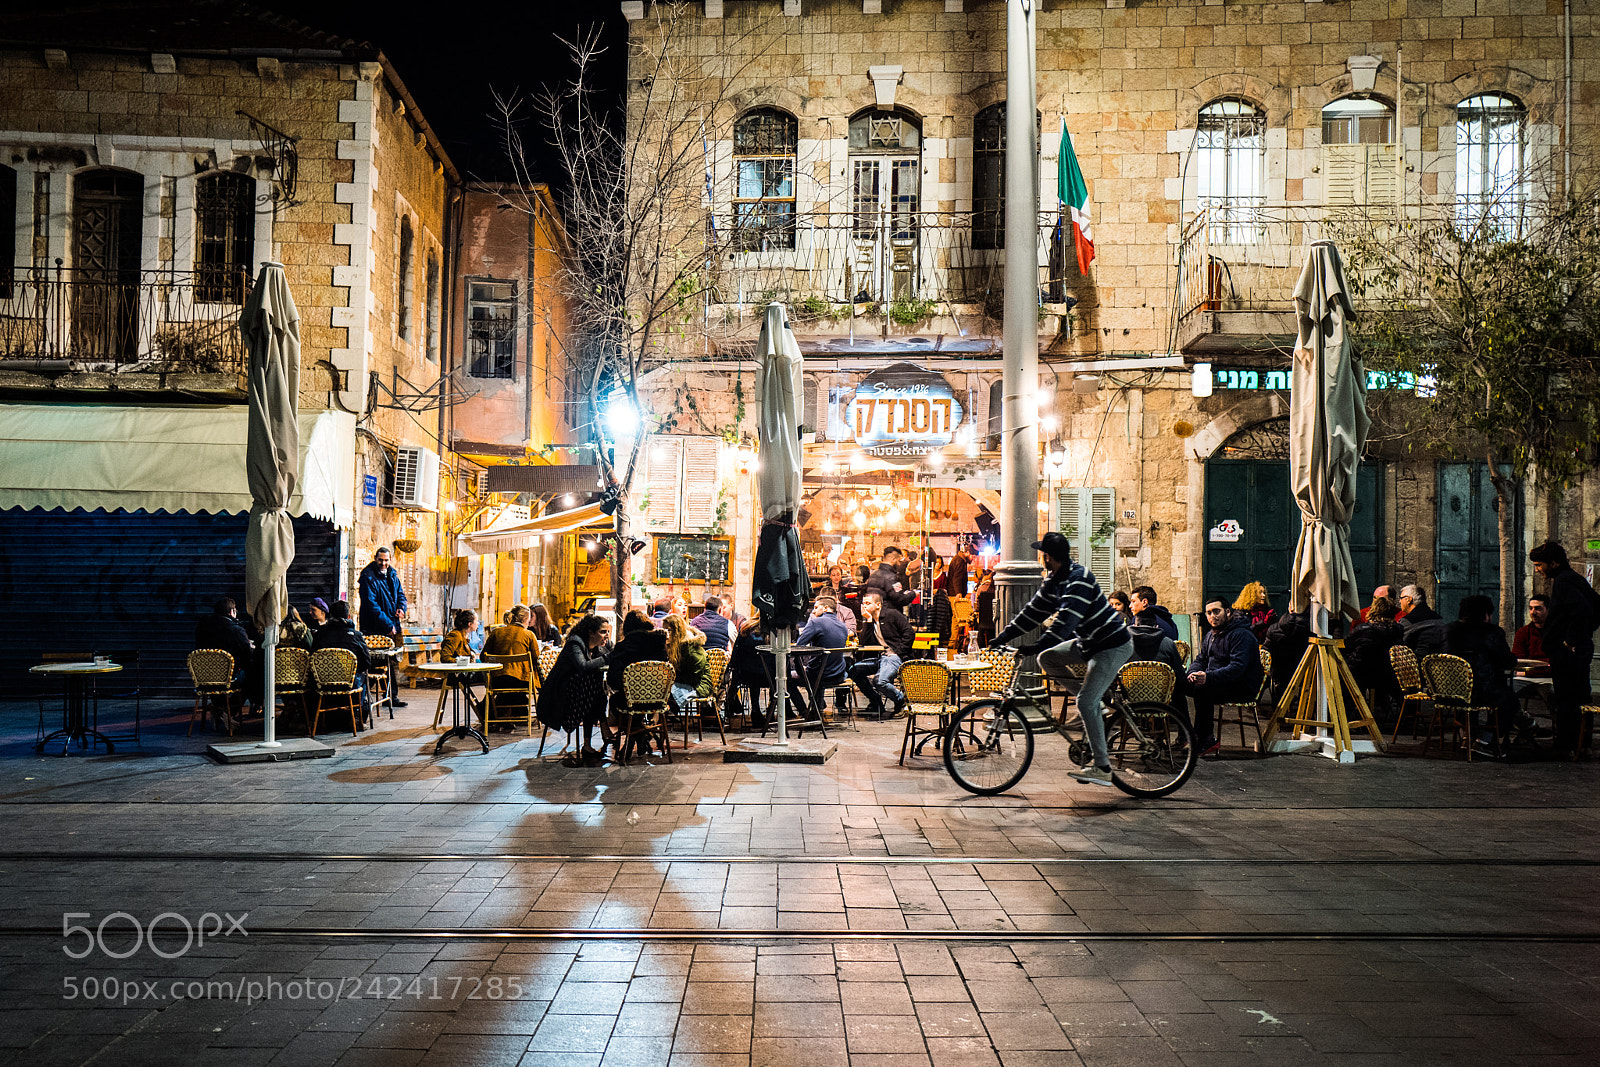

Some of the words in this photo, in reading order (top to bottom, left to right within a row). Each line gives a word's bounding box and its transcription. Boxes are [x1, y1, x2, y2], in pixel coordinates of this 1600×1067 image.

[1217, 370, 1259, 389] מני
[873, 382, 908, 395] Since
[910, 383, 929, 395] 1986
[856, 398, 952, 438] הסנדק
[1124, 511, 1135, 519] 102
